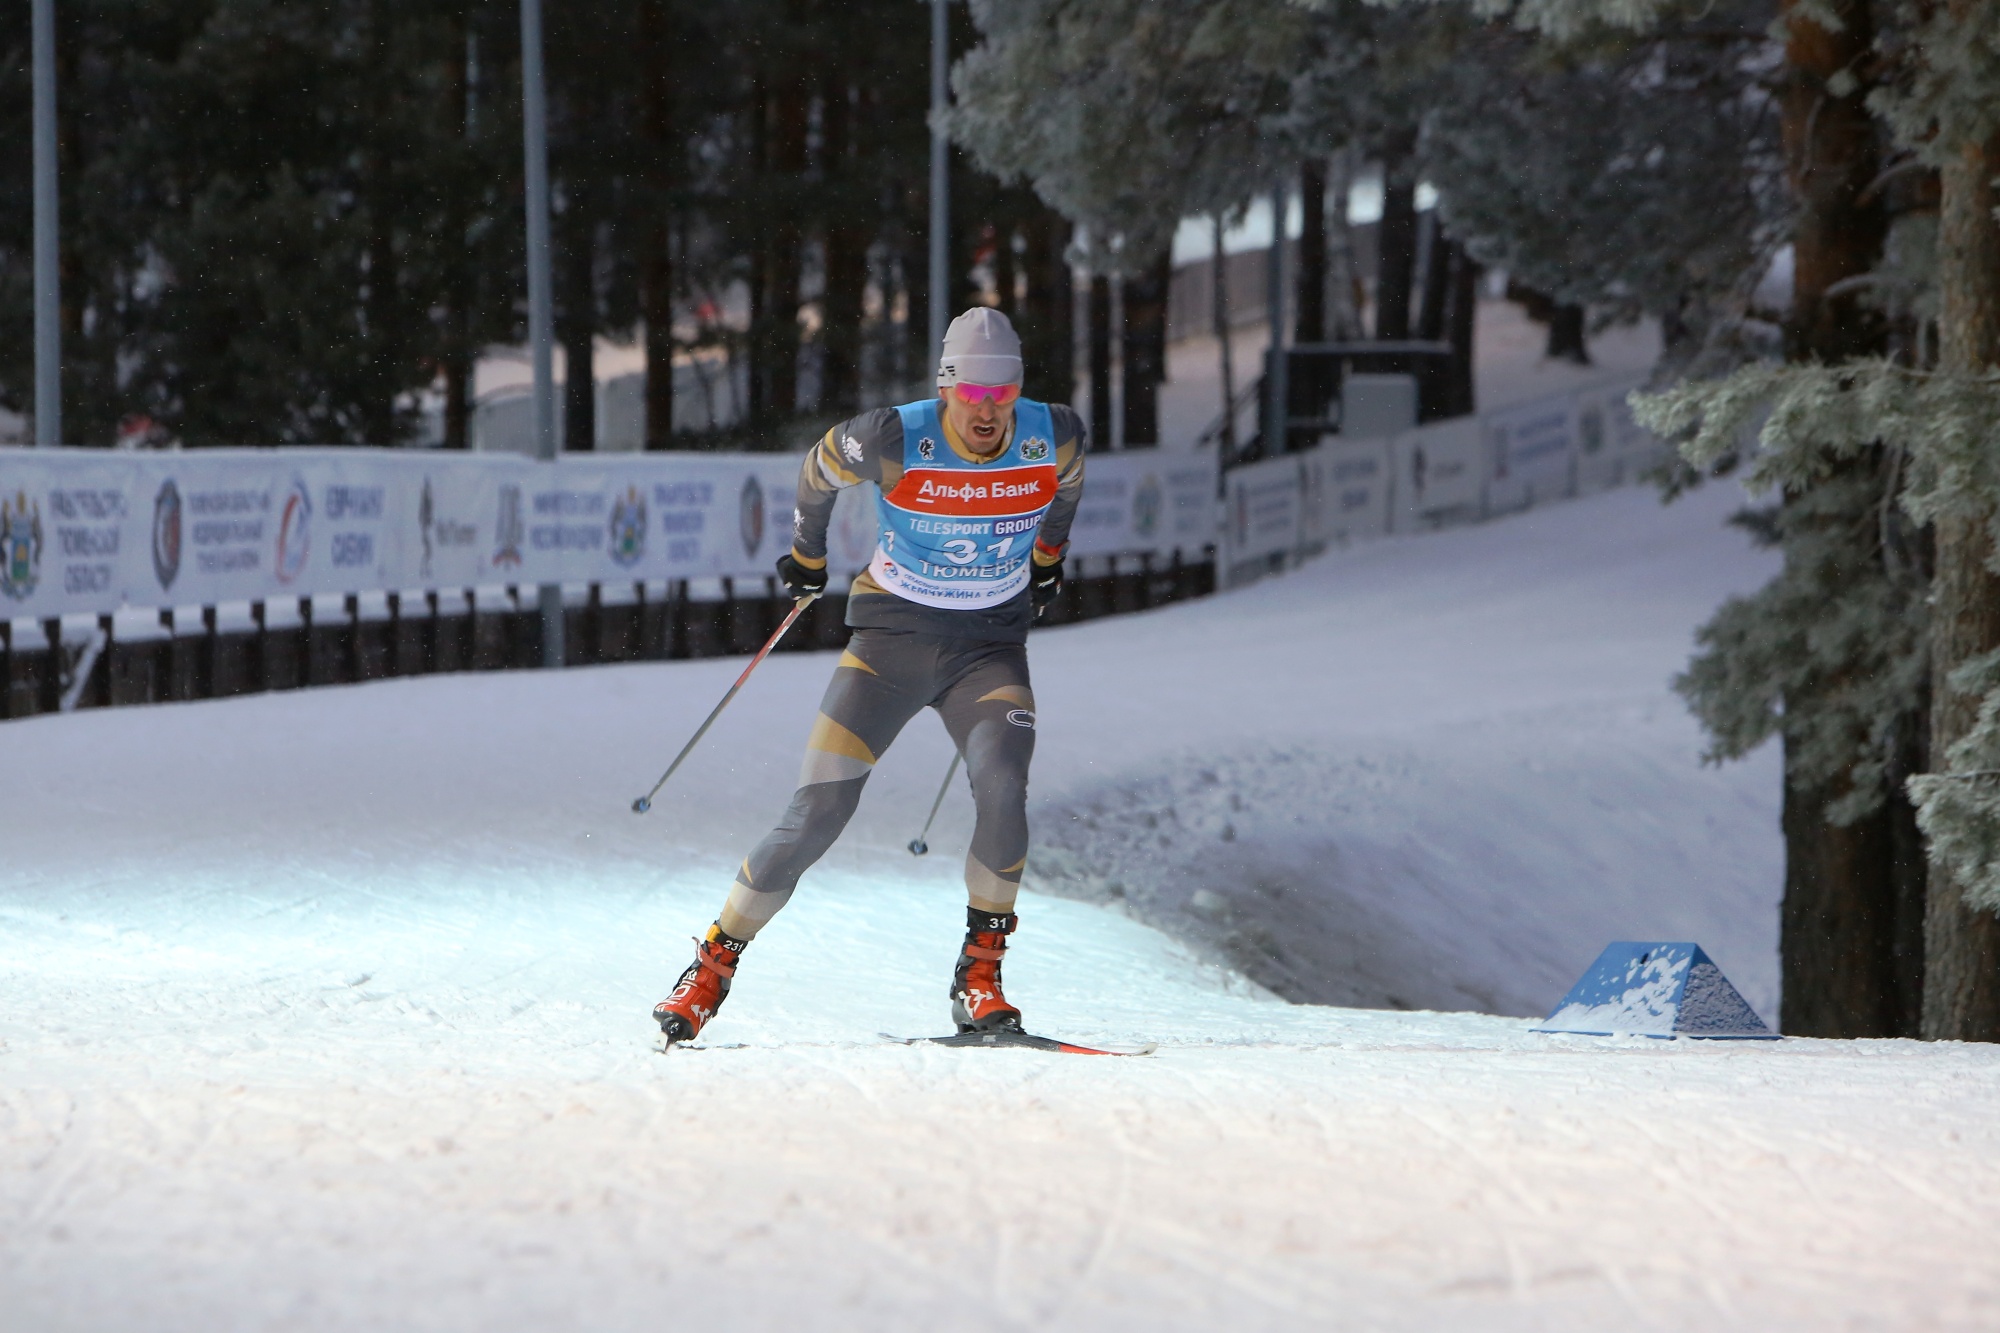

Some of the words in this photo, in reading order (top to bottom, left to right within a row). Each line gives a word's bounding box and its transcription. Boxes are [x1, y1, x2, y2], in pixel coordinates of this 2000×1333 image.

[916, 479, 987, 503] Альфа
[991, 480, 1040, 498] Банк
[909, 518, 991, 535] TELESPORT
[995, 515, 1041, 535] GROUP
[942, 537, 1015, 565] 31
[918, 557, 1022, 578] ТЮМЕНЬ
[988, 916, 1007, 929] 31
[723, 940, 744, 953] 231
